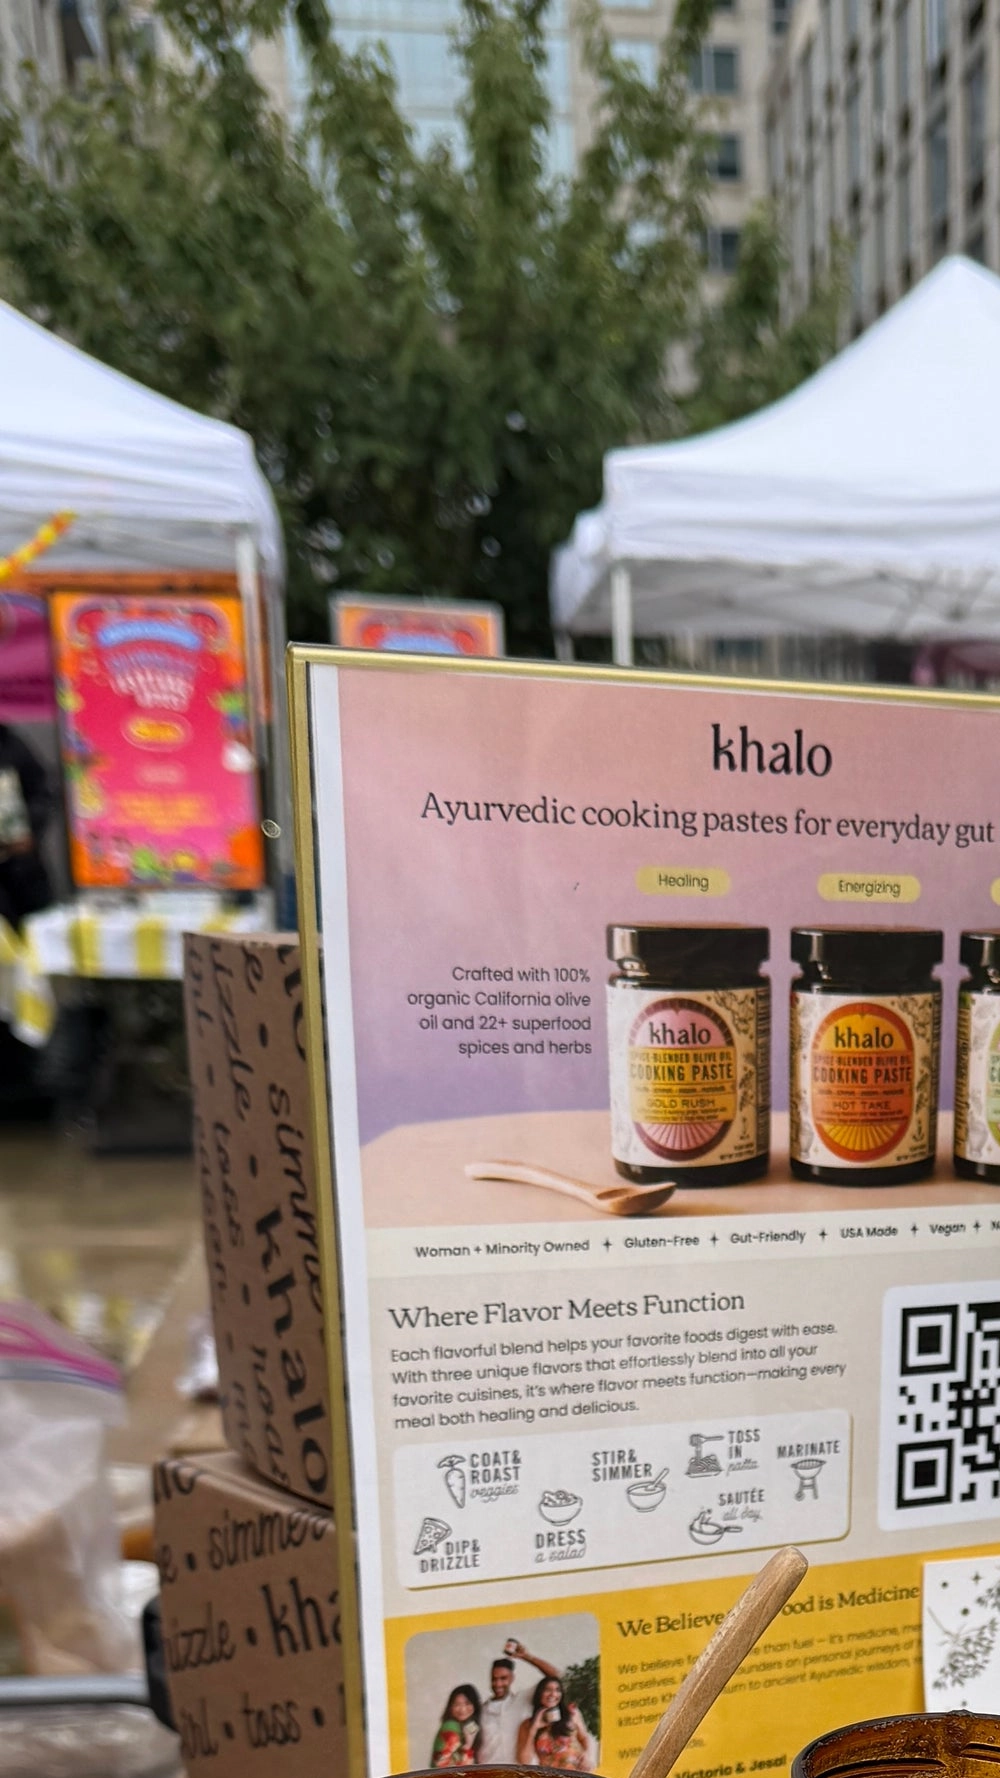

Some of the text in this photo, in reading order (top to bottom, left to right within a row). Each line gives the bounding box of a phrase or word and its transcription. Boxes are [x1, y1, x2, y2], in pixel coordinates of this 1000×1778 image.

[712, 723, 832, 777] khalo
[421, 791, 576, 826] Ayurvedic
[582, 800, 697, 837] cooking
[703, 808, 787, 837] pastes
[795, 808, 832, 836] for
[836, 814, 950, 846] everyday
[956, 822, 995, 848] gut
[658, 873, 709, 893] Healing
[839, 879, 900, 898] Energizing
[452, 966, 591, 982] Crafted with 100%
[407, 991, 591, 1009] organic California olive
[420, 1015, 591, 1034] oil and 22+ superfood
[649, 1021, 711, 1045] khalo
[834, 1025, 894, 1049] khalo
[458, 1040, 592, 1058] spices and herbs
[730, 1229, 806, 1245] Gut-Friendly
[840, 1224, 898, 1239] USA Made
[929, 1222, 966, 1237] Vegan
[414, 1240, 590, 1259] Woman Minority Owned
[624, 1233, 700, 1249] Gluten-Free
[388, 1292, 745, 1329] Where Flavor Meets Function
[255, 1209, 328, 1493] khalo
[390, 1322, 838, 1363] Each flavorful blend helps your favorite foods digest with ease.
[392, 1344, 818, 1385] With three unique flavors that effortlessly blend into your
[393, 1363, 847, 1408] favorite cuisines, where flavor meets every
[395, 1399, 640, 1430] meal both healing and delicious.
[728, 1429, 761, 1444] TOSS
[776, 1440, 840, 1459] MARINATE
[470, 1466, 520, 1484] ROAST
[591, 1463, 653, 1483] SIMMER
[535, 1529, 587, 1549] DRESS
[419, 1554, 481, 1574] DRIZZLE
[617, 1585, 920, 1638] We Believe ood is Medicine
[240, 1691, 302, 1750] toss
